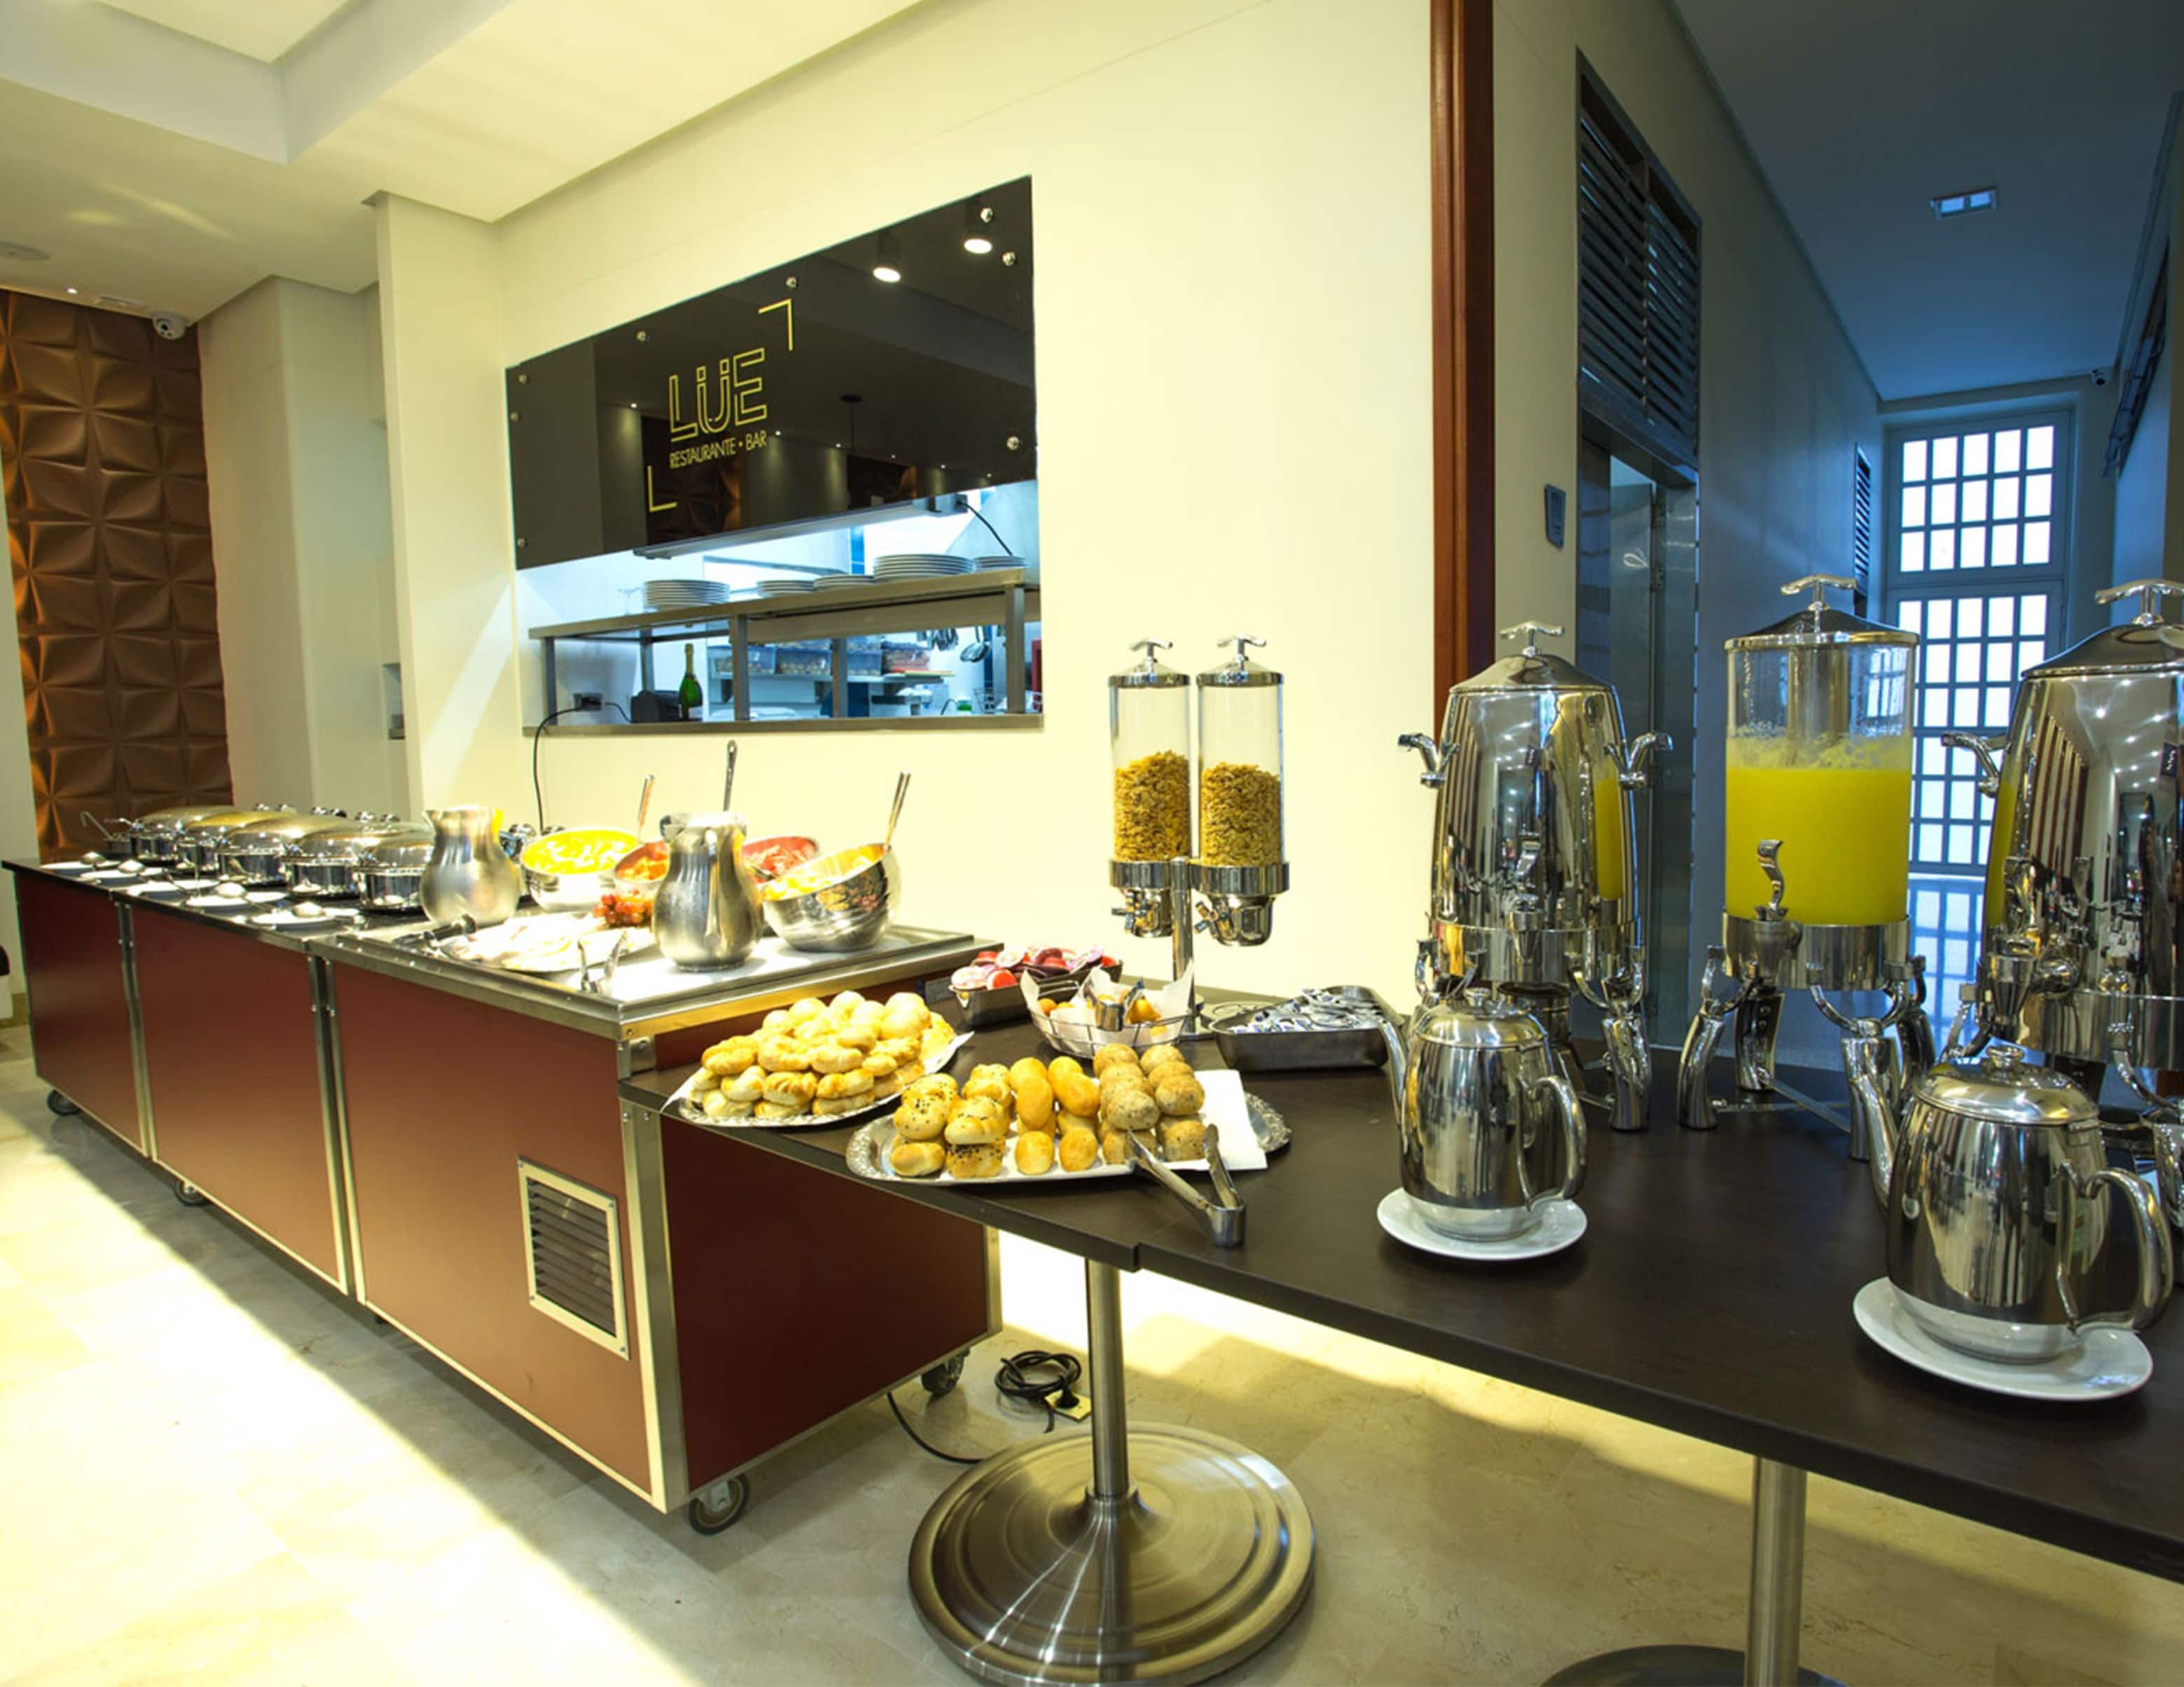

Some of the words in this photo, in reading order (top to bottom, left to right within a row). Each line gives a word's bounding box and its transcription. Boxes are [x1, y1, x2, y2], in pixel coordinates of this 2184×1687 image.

[669, 347, 768, 443] LÜE
[669, 437, 736, 469] RESTAURANTE
[745, 429, 768, 450] BAR
